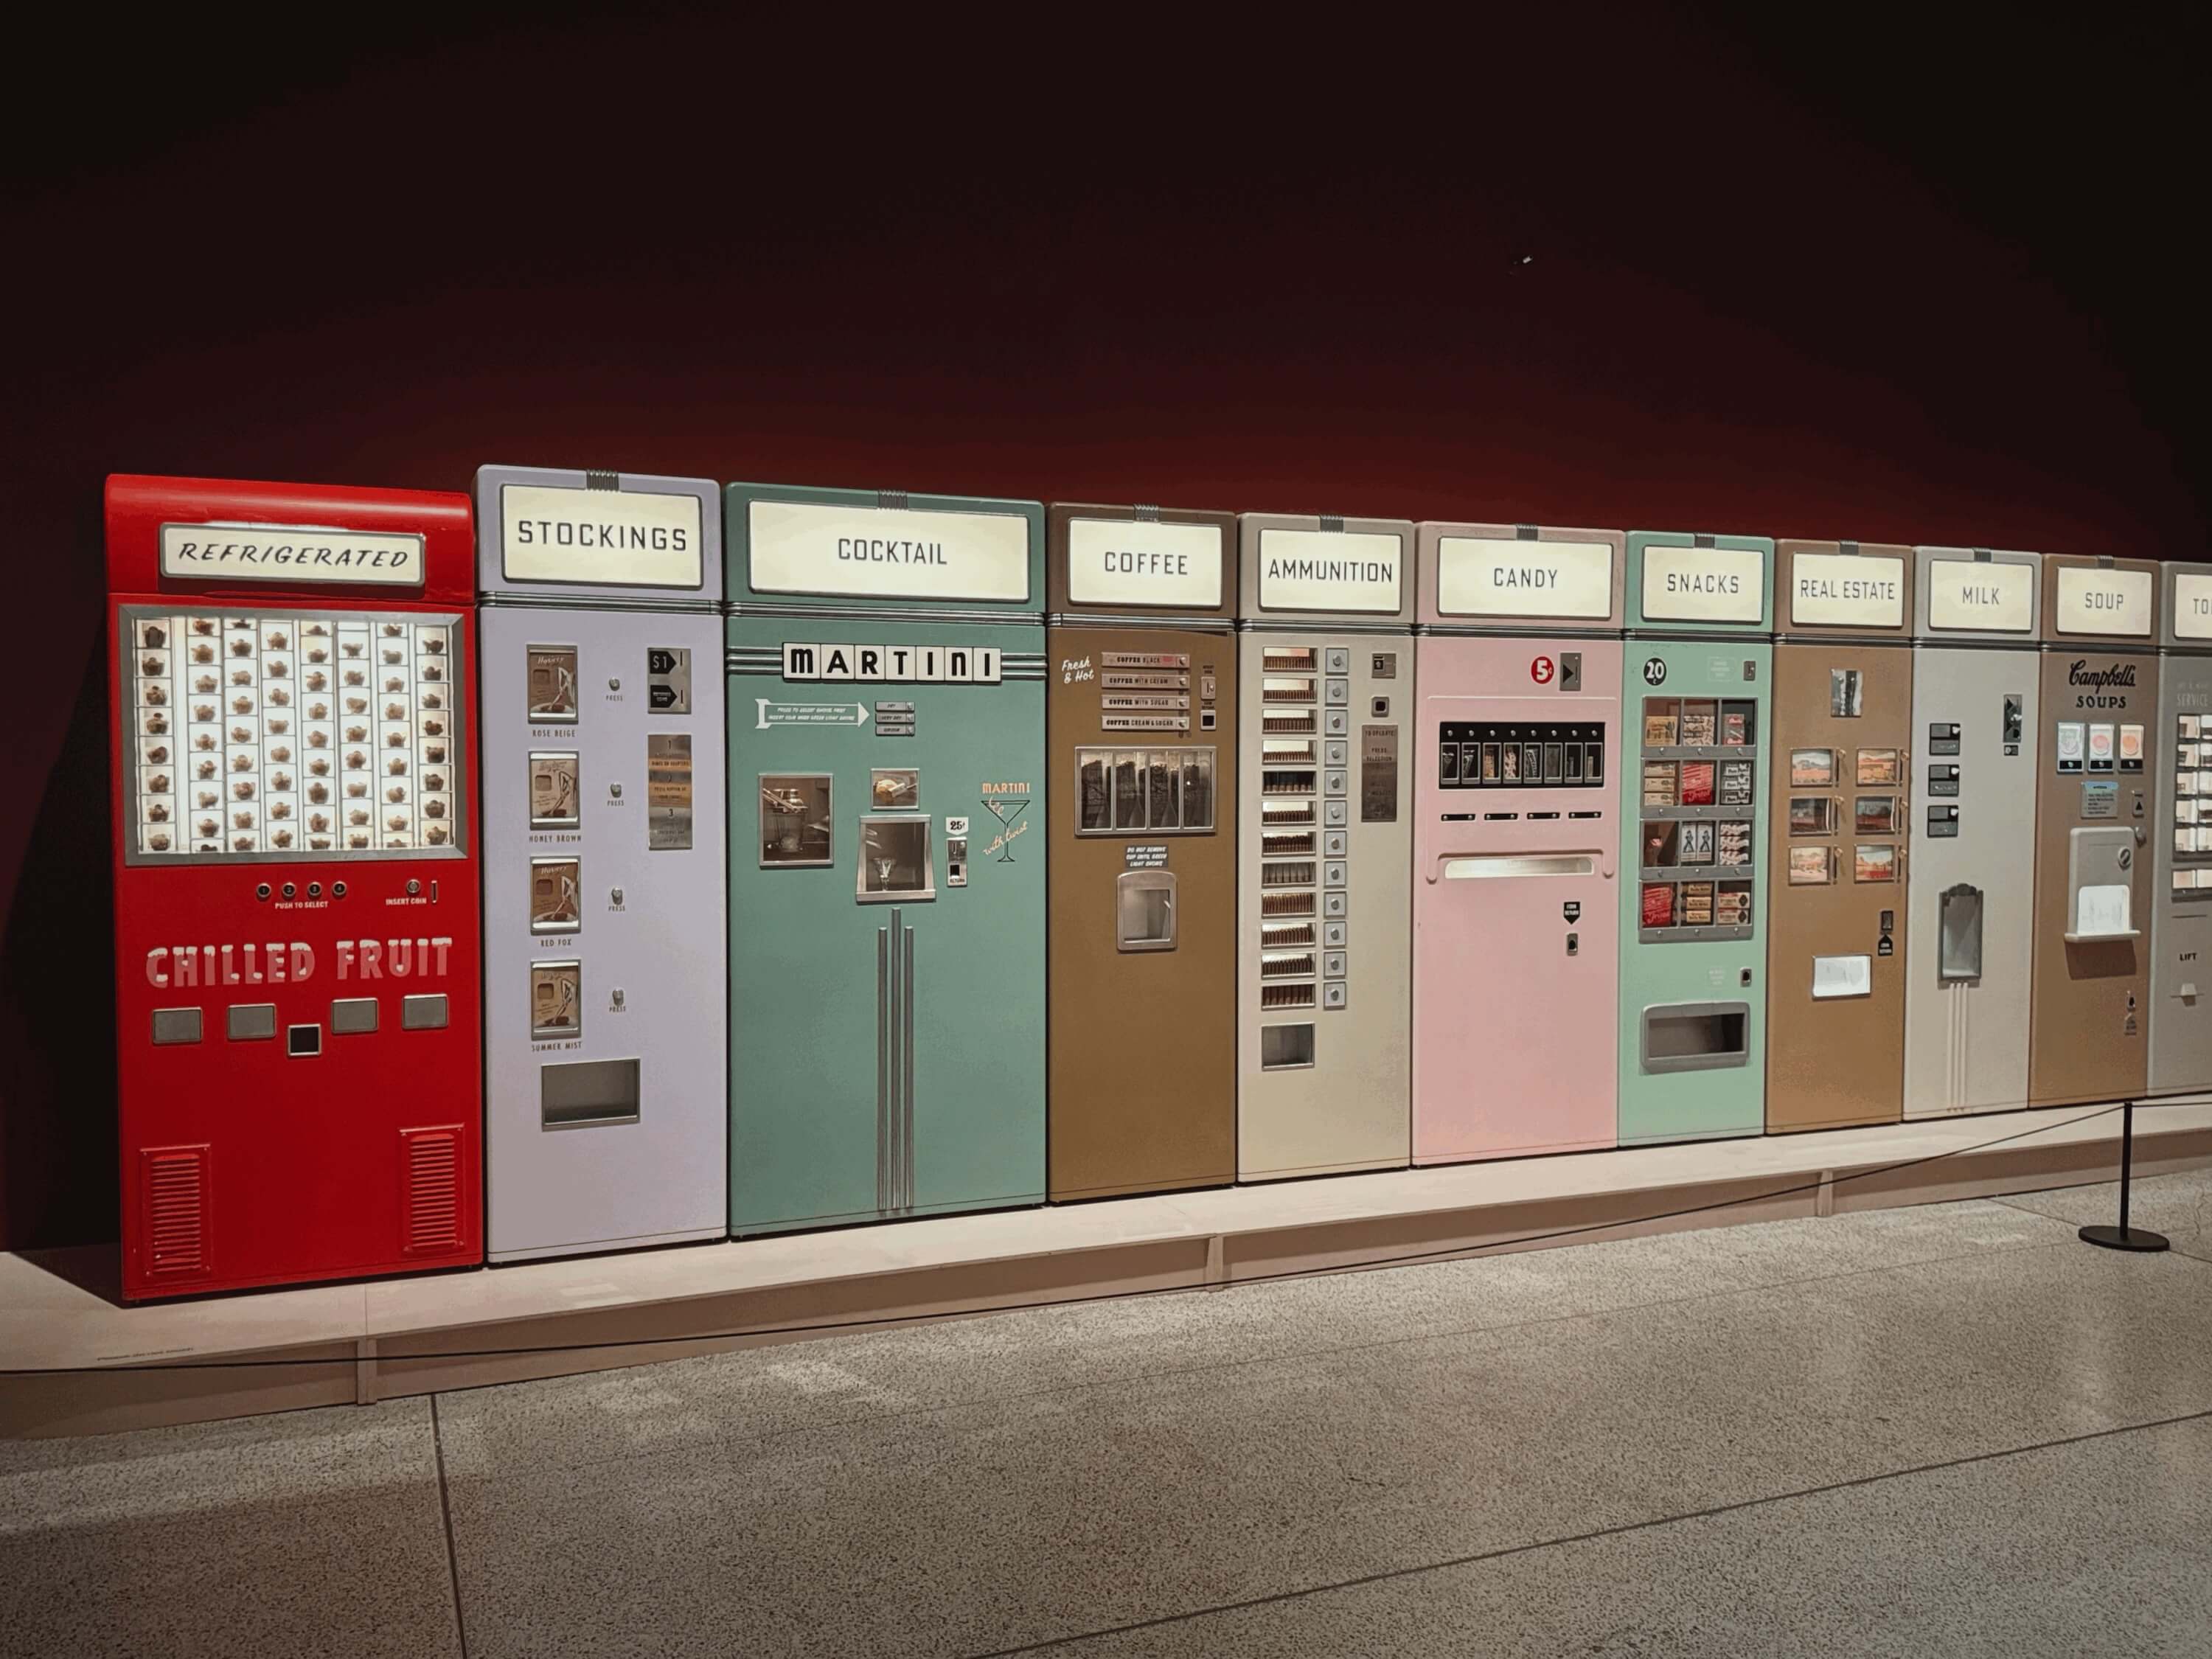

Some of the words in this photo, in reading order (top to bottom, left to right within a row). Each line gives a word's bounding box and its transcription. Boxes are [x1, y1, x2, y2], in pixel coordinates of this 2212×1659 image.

[518, 520, 686, 552] STOCKINGS
[178, 543, 408, 568] REFRIGERATED
[838, 538, 947, 566] COCKTAIL
[1105, 551, 1189, 575] COFFEE
[1267, 558, 1393, 583] AMMUNITION
[1493, 568, 1557, 589] CANDY
[1666, 572, 1739, 594] SNACKS
[1801, 579, 1837, 598] REAL
[1843, 580, 1895, 600] ESTATE
[1962, 586, 2000, 605] MILK
[2085, 592, 2124, 611] SOUP
[2193, 598, 2212, 615] TO
[790, 648, 990, 676] MARTINI
[1062, 655, 1091, 672] Fresh
[1646, 661, 1665, 679] 20
[1064, 672, 1071, 684] &
[1075, 669, 1094, 681] Hot
[2069, 660, 2136, 695] Campbell's
[2076, 695, 2127, 709] SOUPS
[532, 729, 551, 737] ROSE
[554, 729, 575, 737] BEIGE
[982, 782, 1030, 794] MARTINI
[529, 835, 552, 843] HONEY
[983, 834, 1004, 855] with
[304, 900, 329, 908] SELECT
[146, 942, 316, 988] CHILLED
[336, 937, 453, 979] FRUIT
[2180, 952, 2198, 961] LIFT
[532, 1043, 562, 1052] SUMMER
[565, 1041, 582, 1049] MIST
